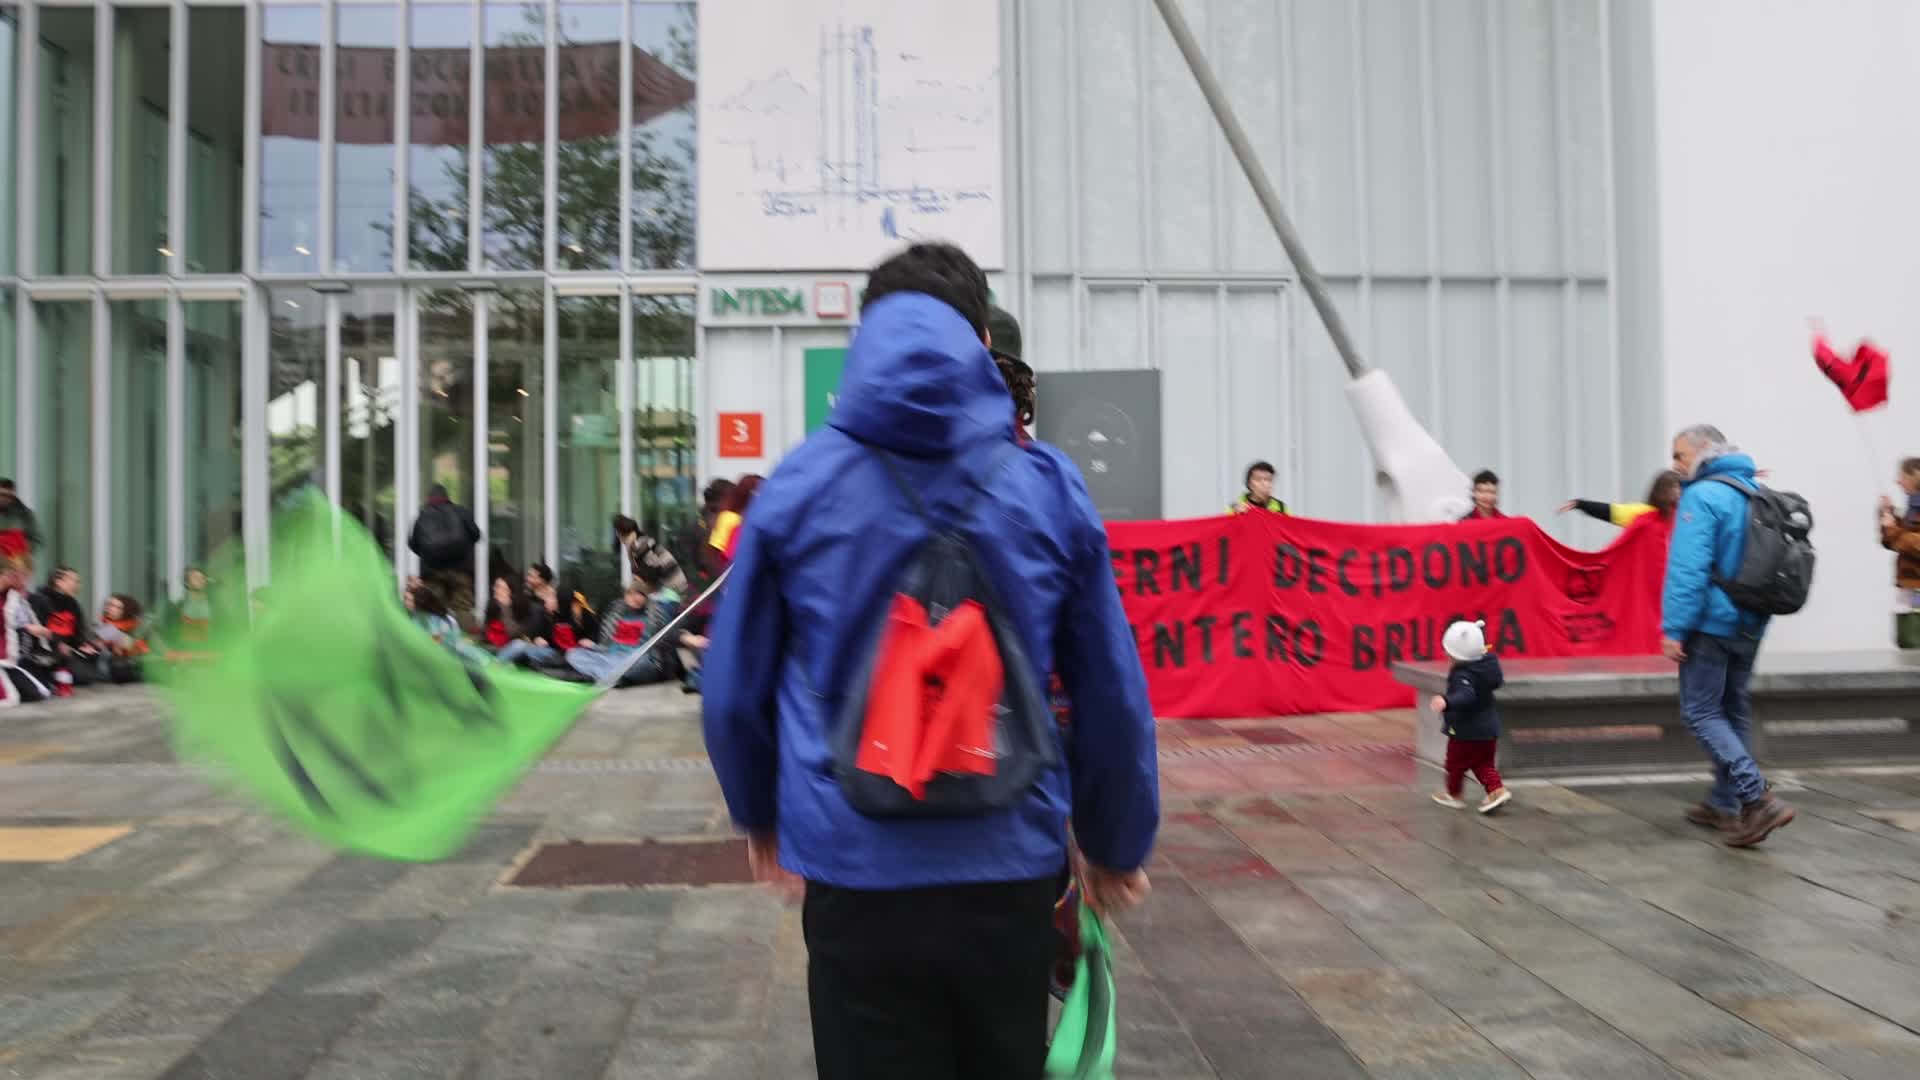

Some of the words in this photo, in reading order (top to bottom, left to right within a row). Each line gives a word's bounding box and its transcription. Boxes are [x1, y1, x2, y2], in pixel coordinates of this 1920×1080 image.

[711, 287, 804, 315] INTESA
[1274, 535, 1527, 597] DECIDONO
[1352, 607, 1527, 671] BRUA
